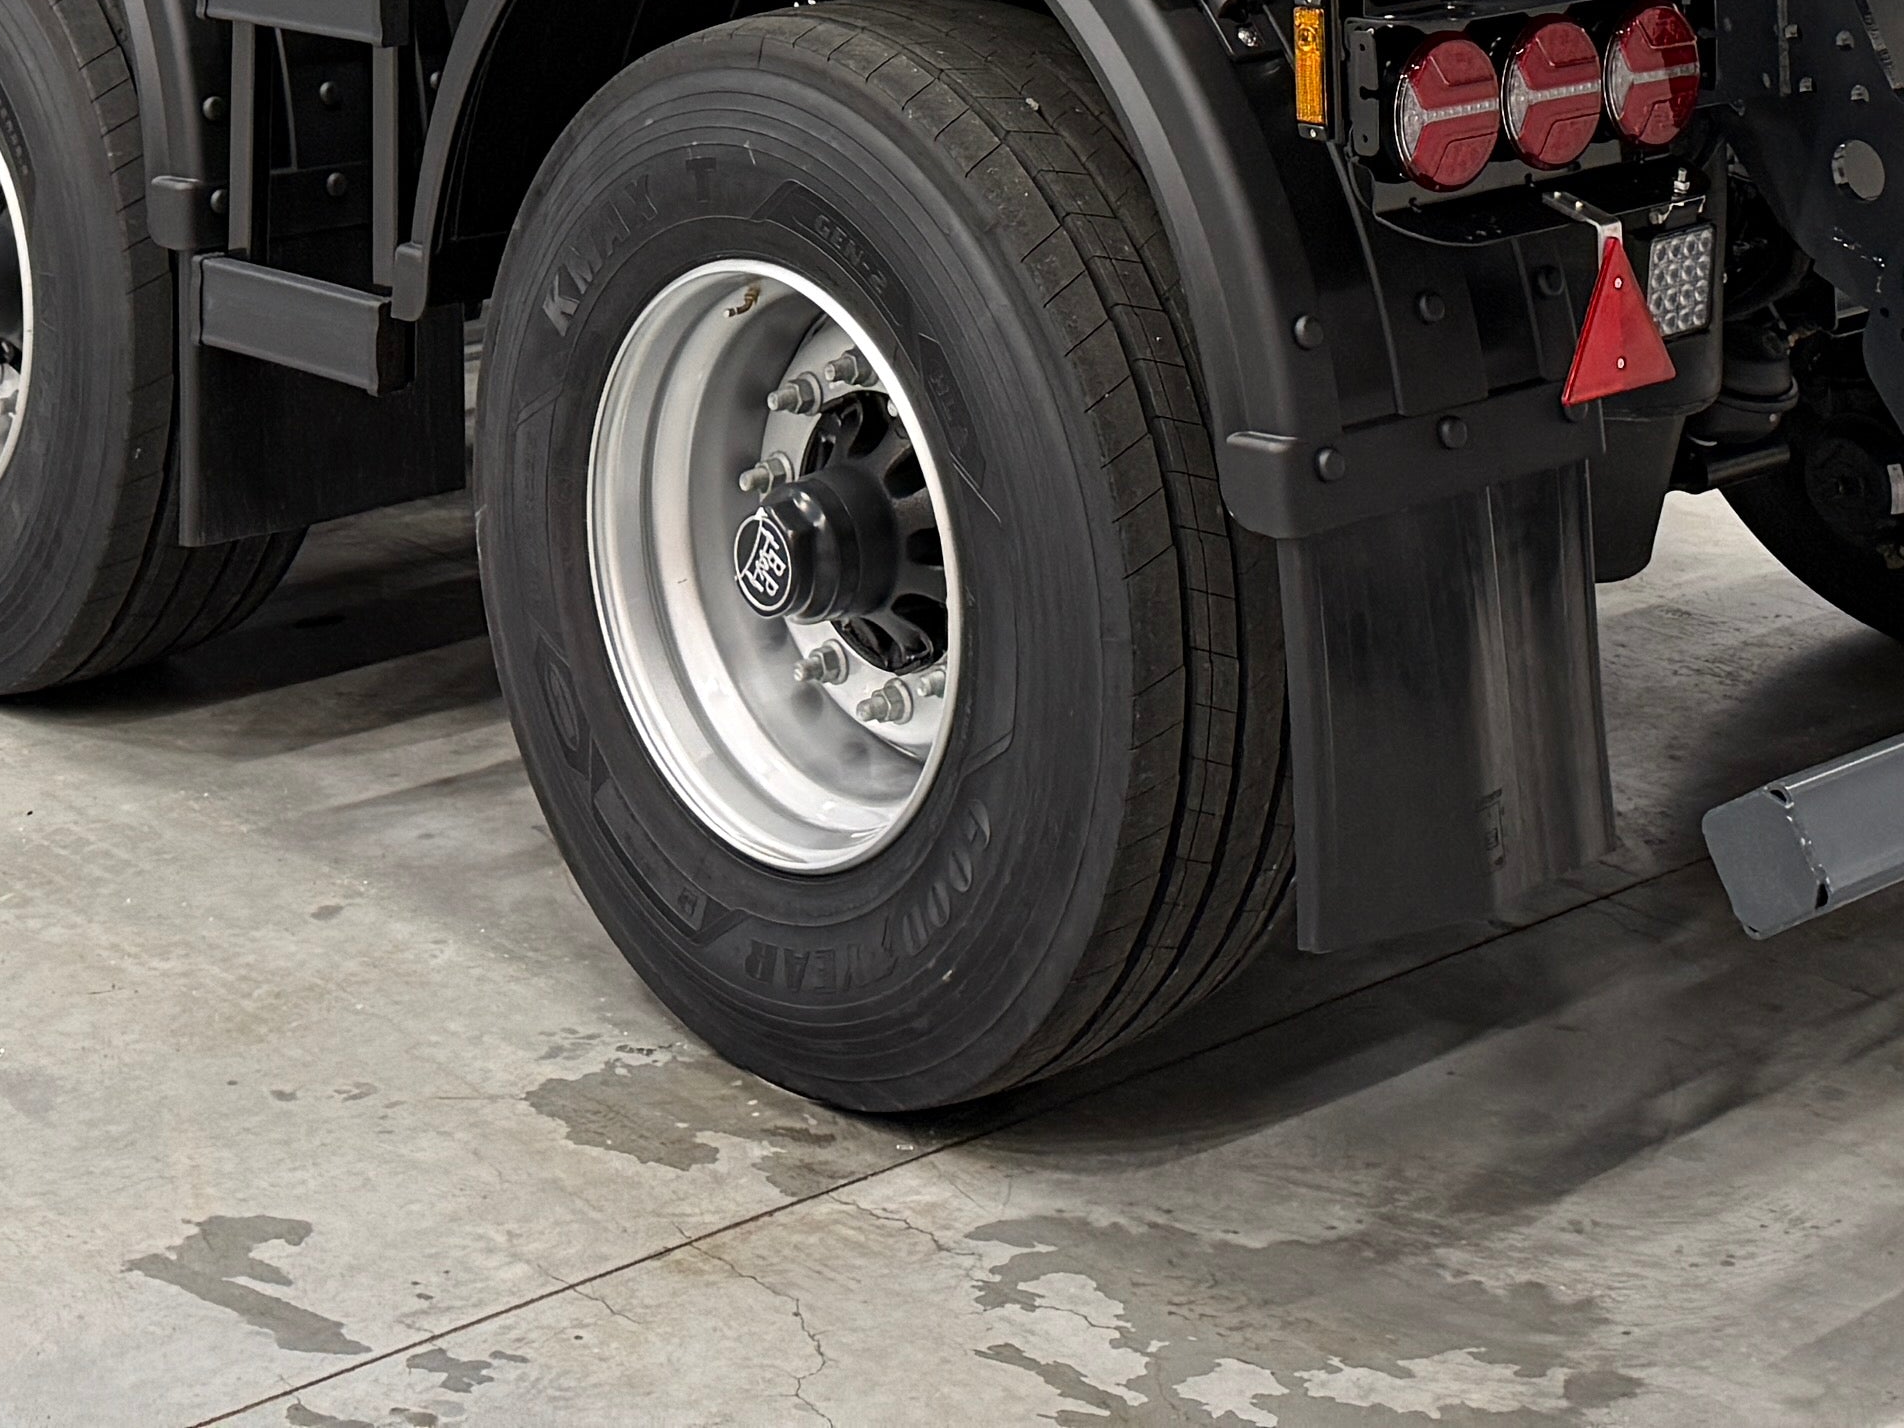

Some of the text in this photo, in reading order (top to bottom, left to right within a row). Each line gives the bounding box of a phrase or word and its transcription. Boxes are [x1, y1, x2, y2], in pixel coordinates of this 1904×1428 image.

[541, 156, 718, 338] KMAX T
[813, 212, 890, 296] GEN-2
[743, 797, 992, 995] GOODYEAR
